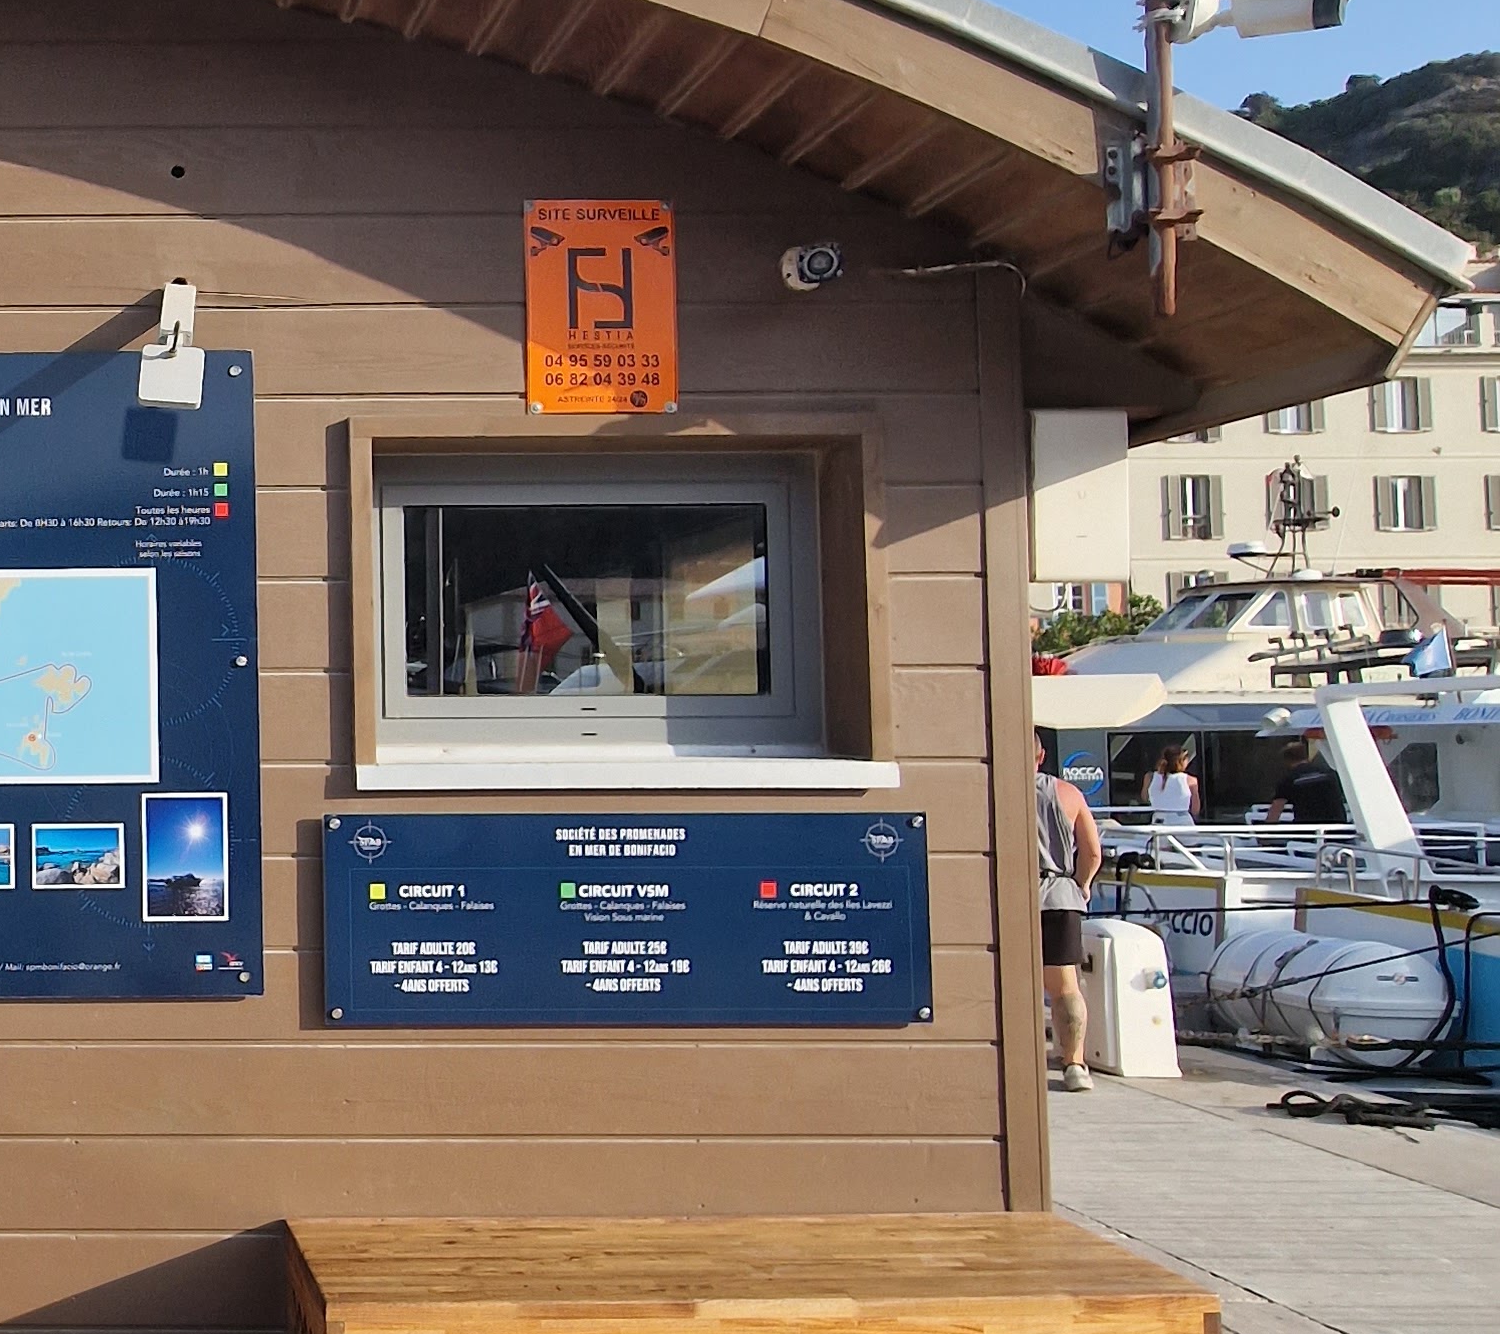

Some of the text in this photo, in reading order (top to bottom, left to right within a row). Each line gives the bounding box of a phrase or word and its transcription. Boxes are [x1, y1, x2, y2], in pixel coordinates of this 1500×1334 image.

[538, 208, 660, 220] SITE SURVEILLE
[568, 330, 633, 340] HESTIA
[545, 354, 660, 367] 04 95 59 03 33
[545, 372, 660, 386] 06 82 04 39 48
[16, 398, 52, 416] MER
[163, 467, 209, 476] Durée 1h
[153, 488, 209, 497] Durée 1h15
[136, 505, 211, 515] Toutes les heures
[19, 518, 33, 527] De
[68, 517, 95, 527] 16h30
[134, 517, 148, 526] De
[149, 516, 177, 526] 12h30
[1063, 767, 1103, 776] ROCCA
[556, 827, 686, 840] SOCIÉTÉ DES PROMENADES
[569, 844, 676, 856] EN MER DE BONIFACIO
[399, 885, 466, 898] CIRCUIT 1
[579, 884, 669, 897] CIRCUIT VSM
[790, 883, 859, 897] CIRCUIT 2
[409, 901, 454, 912] Calanques
[461, 901, 495, 910] Falaises
[599, 901, 645, 912] Calanques
[652, 901, 686, 910] Falaises
[788, 900, 826, 909] naturelle
[828, 900, 844, 909] des
[584, 913, 611, 921] Vision
[612, 913, 633, 921] Sous
[804, 911, 846, 921] & Cavallo
[392, 942, 476, 955] TARIF ADULTE 20€
[583, 941, 667, 955] TARIF ADULTE 25€
[783, 941, 869, 955] TARIF ADULTE 39€
[370, 961, 397, 974] TARIF
[397, 961, 434, 974] ENFANT
[435, 961, 443, 974] 4
[479, 961, 498, 974] 13€
[561, 960, 588, 973] TARIF
[589, 960, 626, 973] ENFANT
[627, 960, 635, 973] 4
[671, 960, 690, 973] 19€
[762, 960, 789, 973] TARIF
[790, 960, 827, 973] ENFANT
[828, 959, 836, 973] 4
[871, 959, 892, 973] 26€
[428, 979, 470, 992] OFFERTS
[620, 978, 661, 992] OFFERTS
[821, 978, 864, 992] OFFERTS
